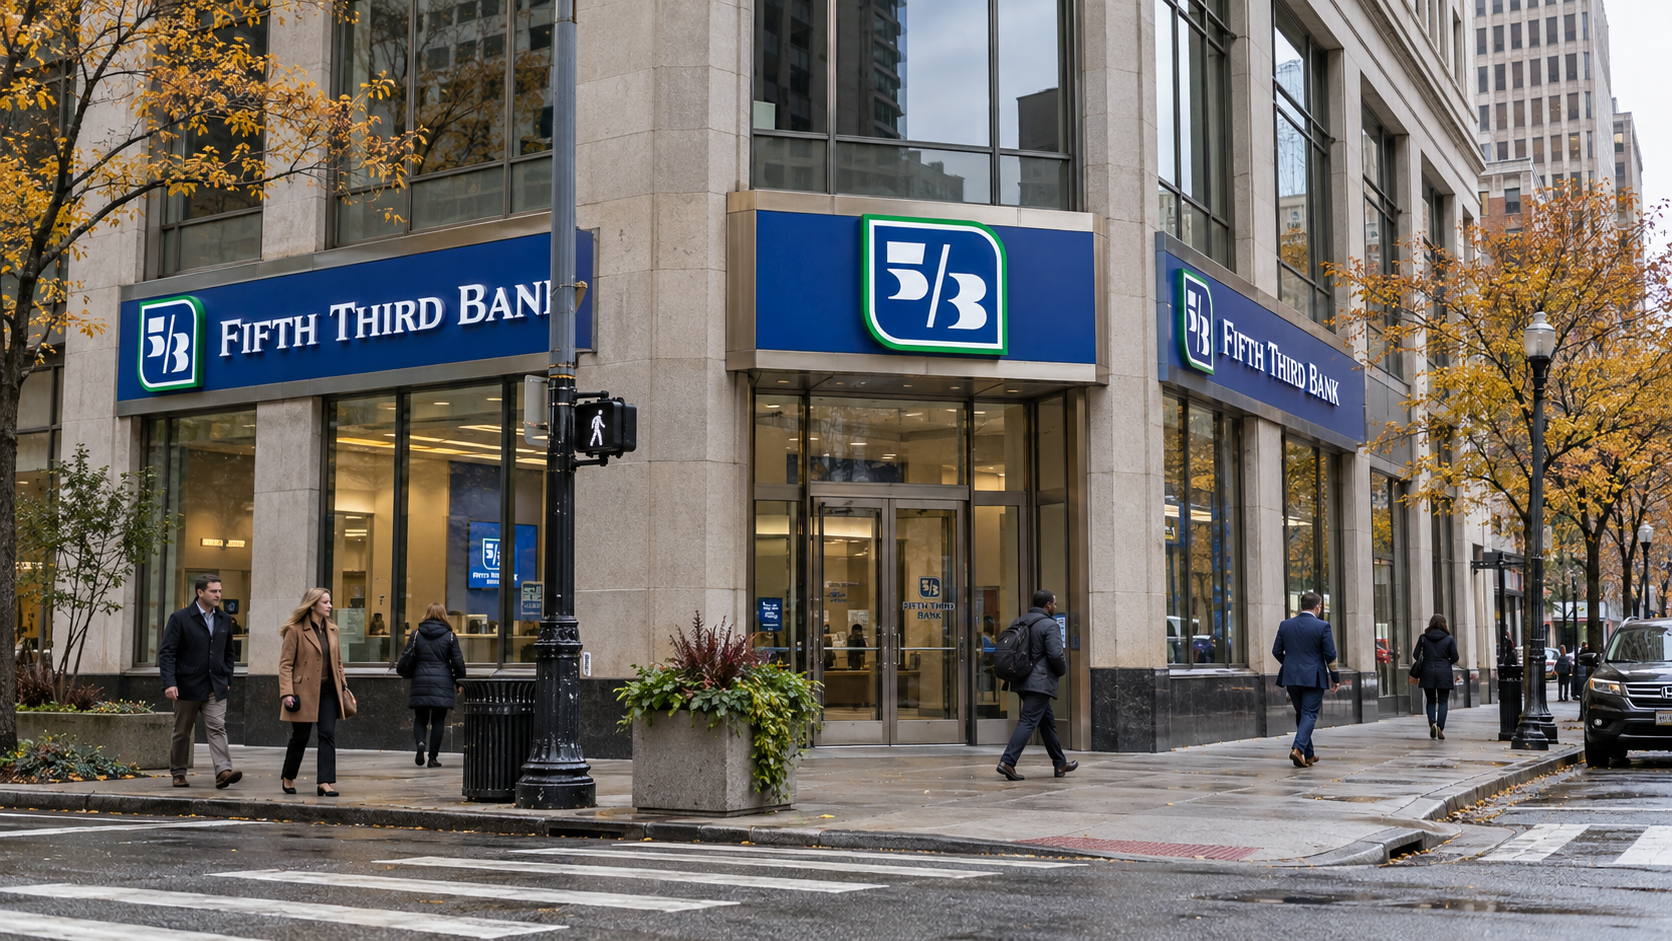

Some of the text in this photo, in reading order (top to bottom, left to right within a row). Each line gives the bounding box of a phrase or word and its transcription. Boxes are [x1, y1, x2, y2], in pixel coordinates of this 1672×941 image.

[887, 241, 988, 330] 5/3
[147, 314, 190, 374] 5/3
[219, 314, 319, 357] FIFTH
[330, 296, 444, 342] THIRD
[1187, 289, 1210, 357] 5/3
[1222, 318, 1340, 407] FIFTH THIRD BANK
